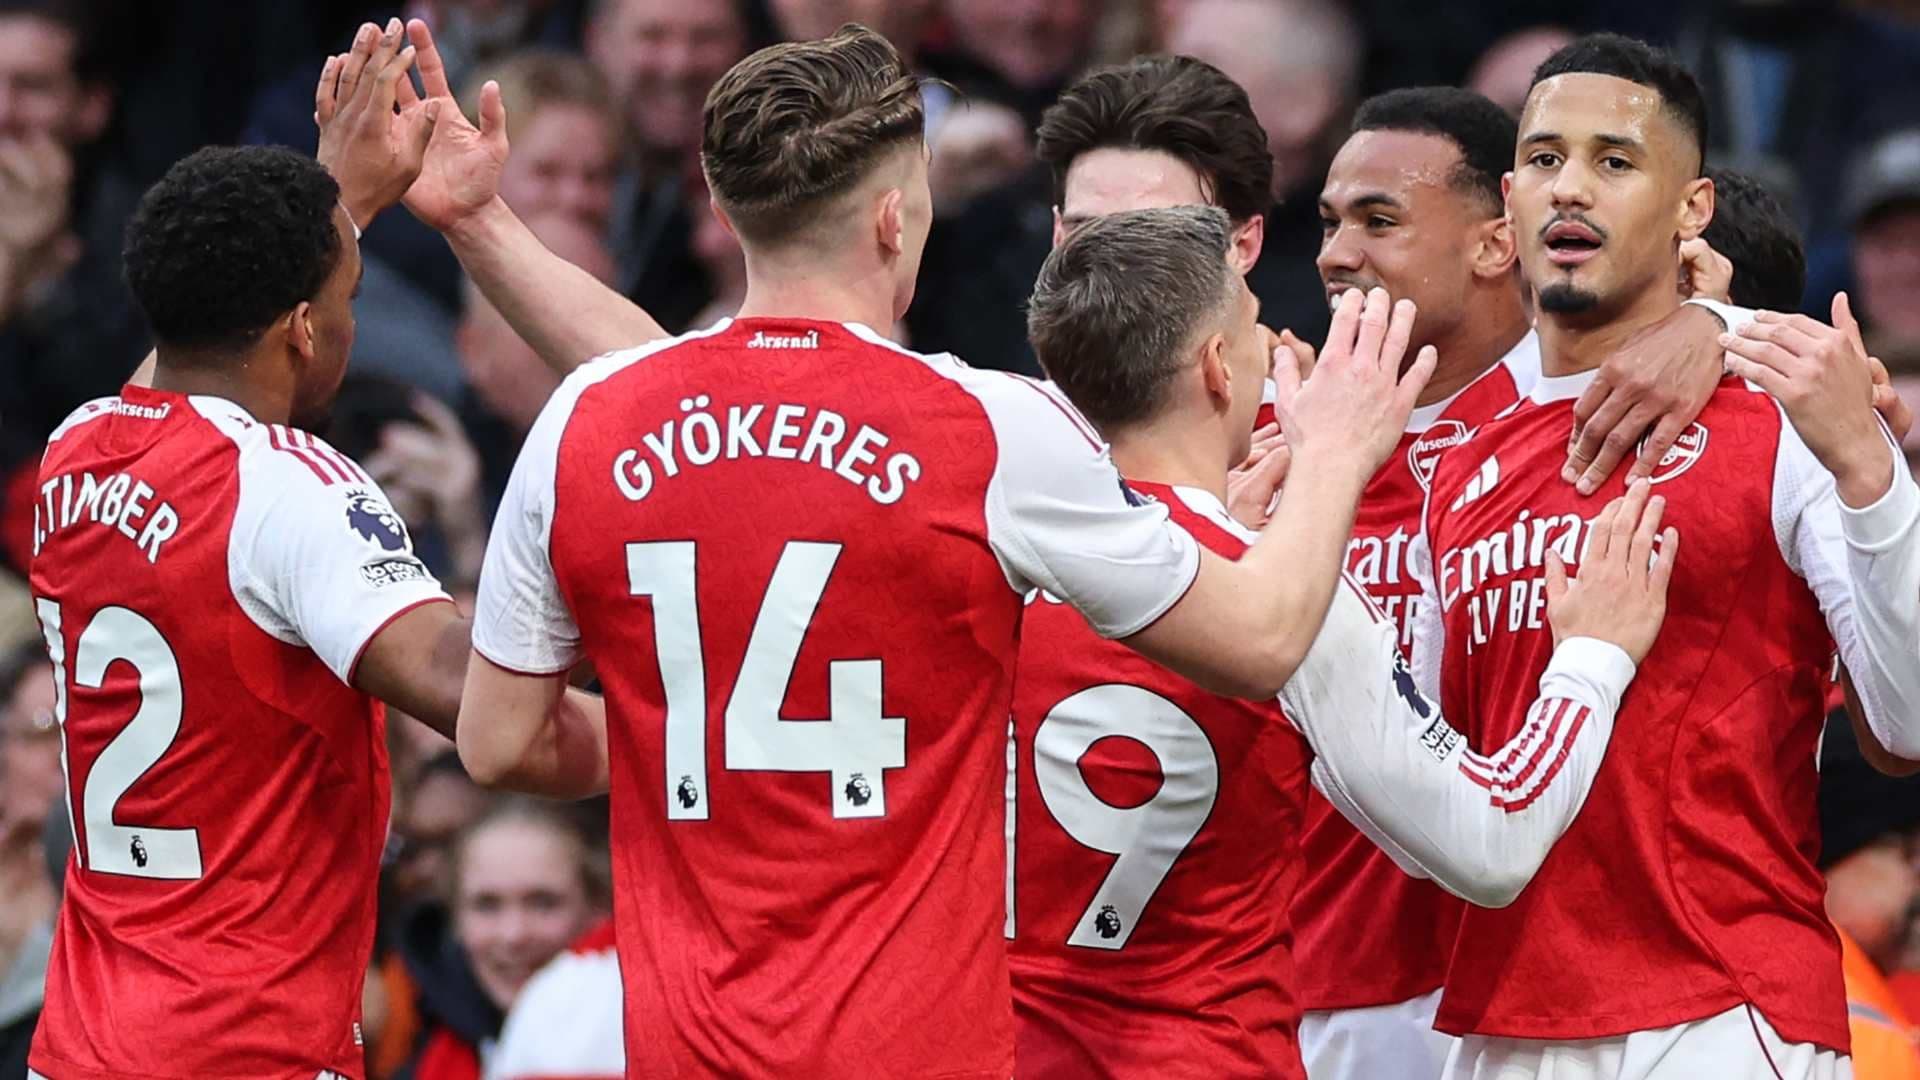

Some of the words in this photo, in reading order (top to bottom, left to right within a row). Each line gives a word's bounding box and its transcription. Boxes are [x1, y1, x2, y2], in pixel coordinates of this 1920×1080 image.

[747, 330, 818, 349] Arsenal
[613, 395, 920, 504] GYÖKERES
[1416, 432, 1460, 453] Arsenal
[625, 540, 906, 820] 14
